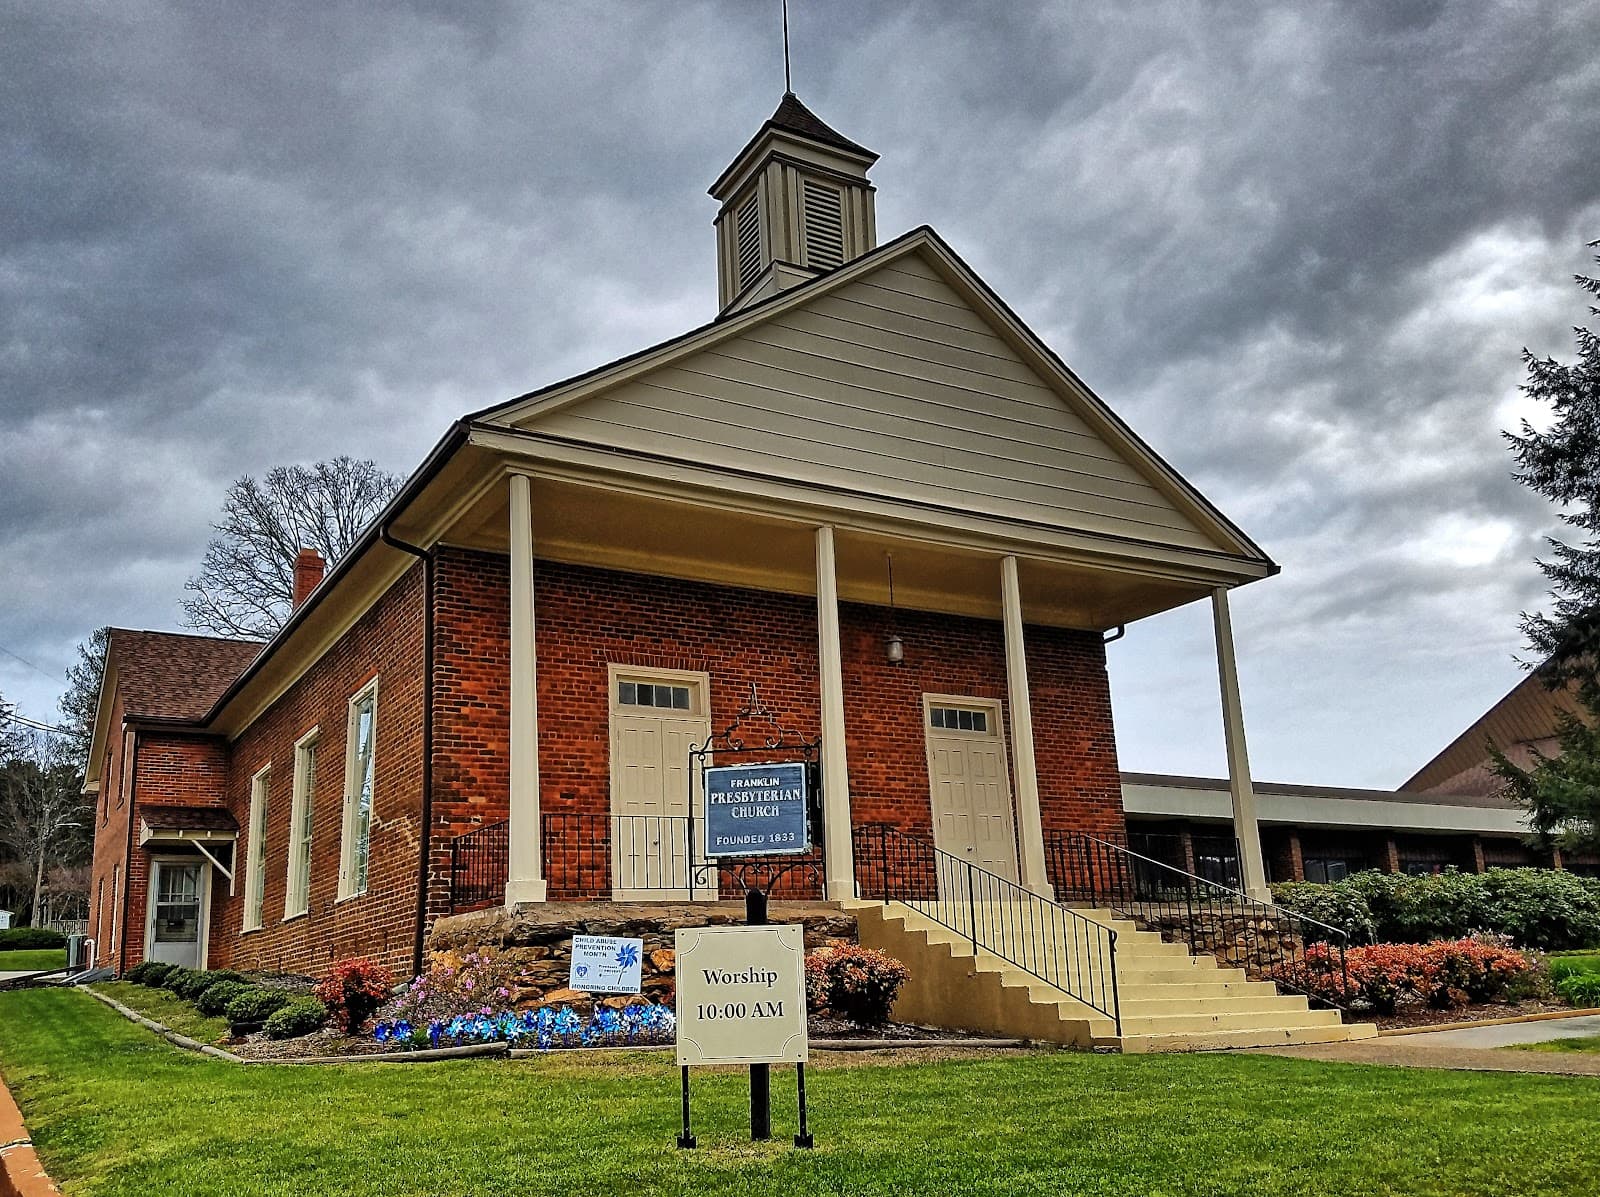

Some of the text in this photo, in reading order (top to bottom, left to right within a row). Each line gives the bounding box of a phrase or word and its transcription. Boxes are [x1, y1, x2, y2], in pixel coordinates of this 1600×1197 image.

[730, 777, 780, 788] FRANKLIN
[710, 788, 801, 804] PRESBYTERIAN
[731, 805, 780, 818] CHURCH
[716, 832, 795, 846] FOUNDED 1833
[702, 966, 778, 988] Worship
[571, 983, 606, 991] HONORING
[697, 1001, 784, 1020] 10:00 AM
